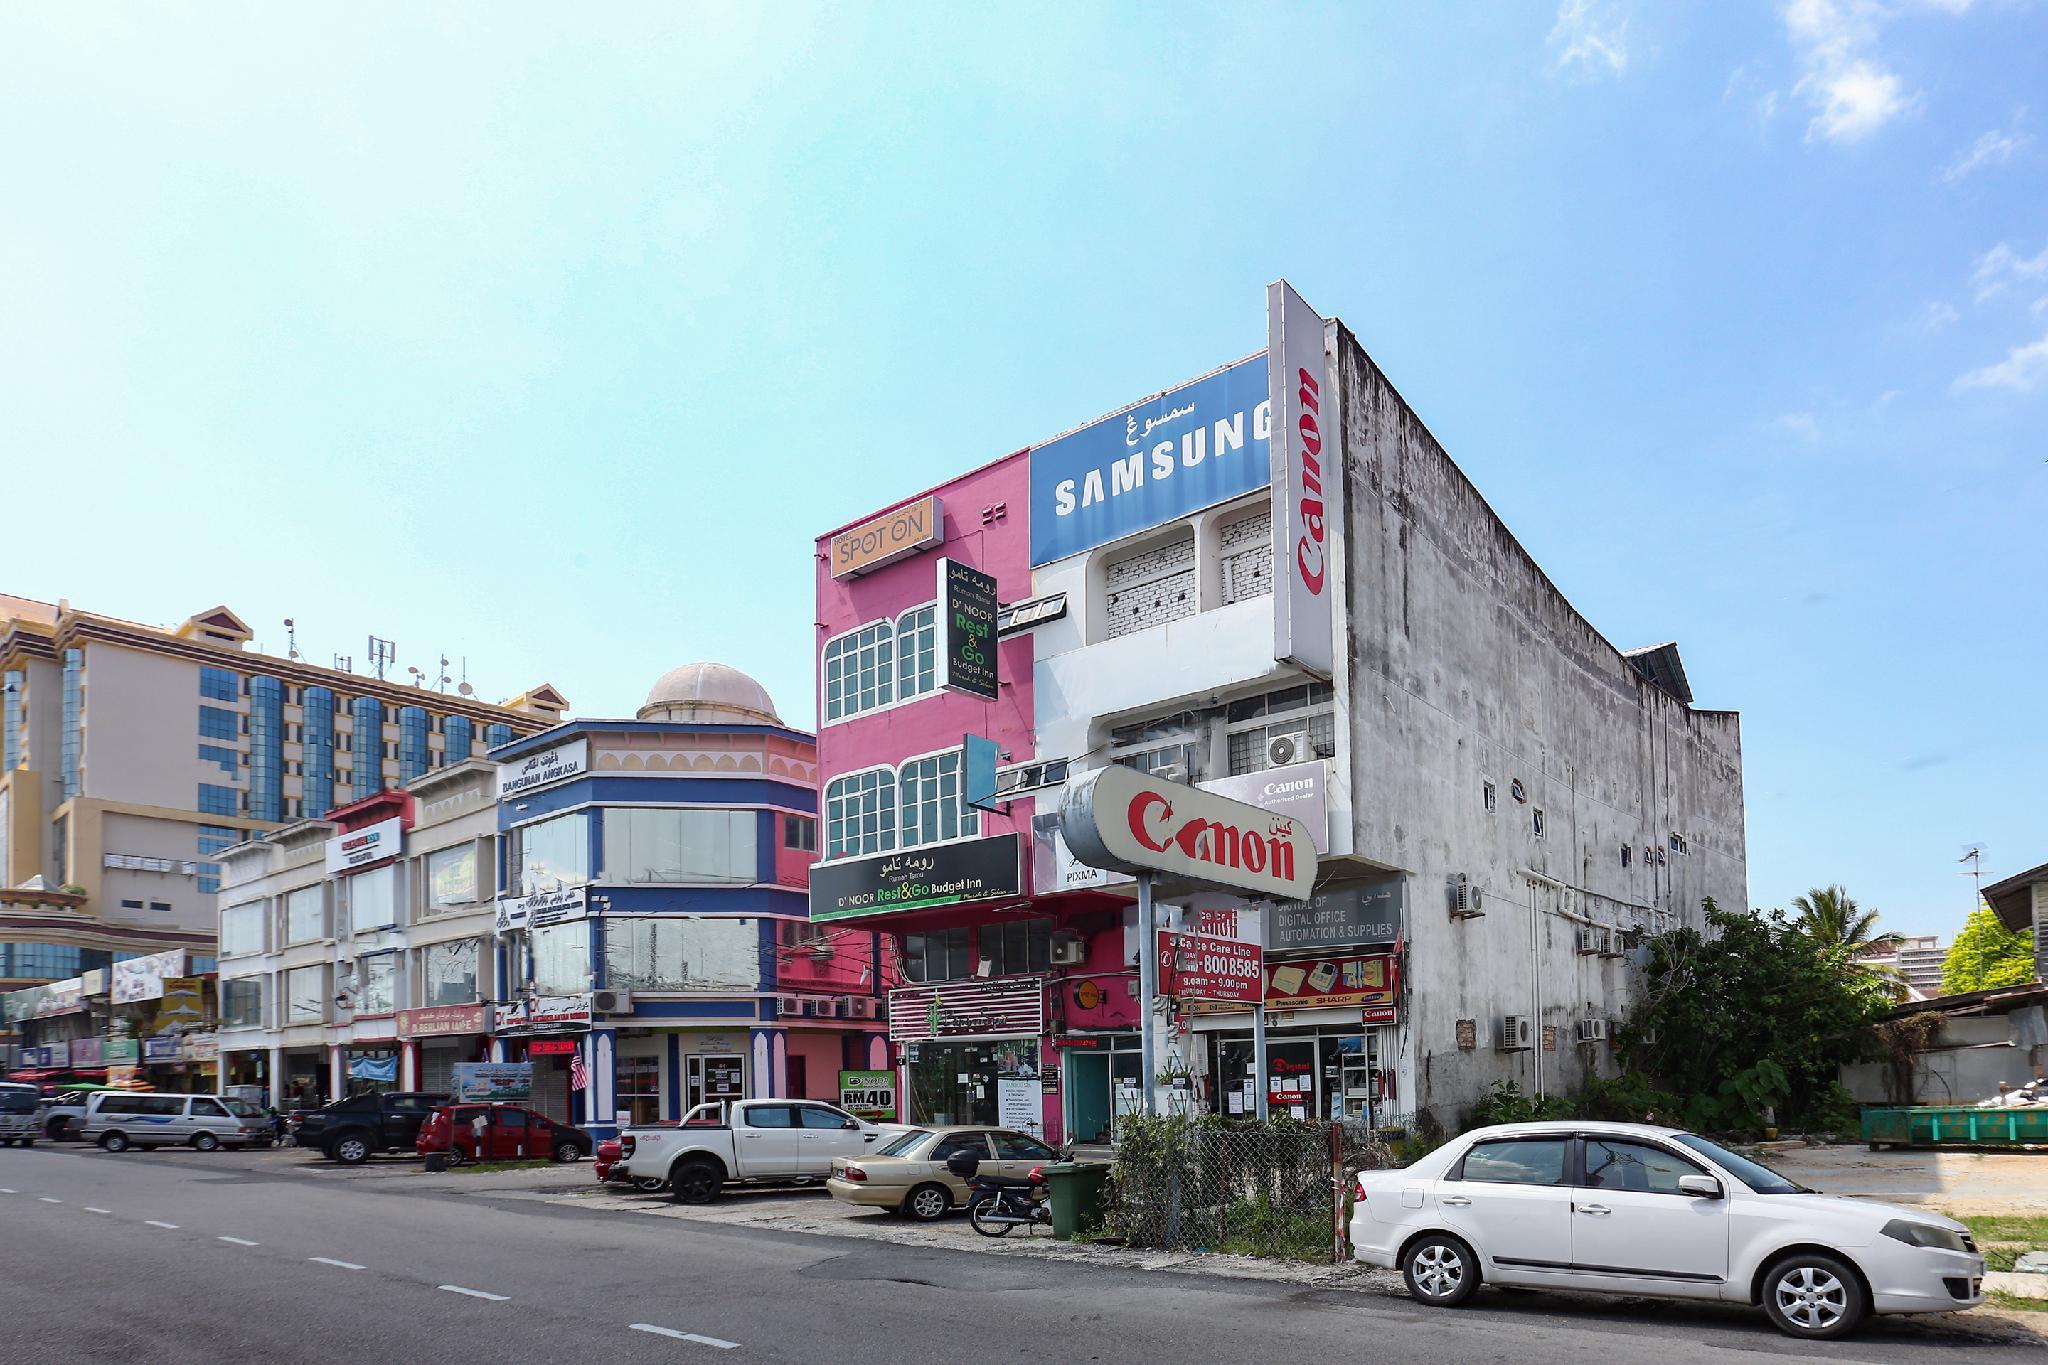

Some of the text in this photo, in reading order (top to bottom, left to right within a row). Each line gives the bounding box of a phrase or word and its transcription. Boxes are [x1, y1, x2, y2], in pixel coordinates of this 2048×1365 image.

[1055, 400, 1271, 517] SAMSUNG
[1297, 368, 1324, 596] Canon
[840, 526, 886, 564] SPOT
[891, 510, 923, 541] ON
[964, 603, 993, 623] NOOR
[956, 613, 989, 638] Rest
[968, 634, 978, 649] &
[962, 645, 985, 665] Go
[953, 657, 981, 675] Budget
[543, 761, 579, 781] ANGKASA
[1264, 777, 1313, 795] Canon
[1127, 791, 1295, 881] Canon
[1066, 868, 1098, 883] PIXMA
[849, 894, 874, 906] NOOR
[931, 878, 965, 896] Budget
[967, 878, 982, 889] Inn
[1278, 910, 1346, 927] DIGITAL OFFICE
[1280, 926, 1336, 942] AUTOMATION
[1348, 923, 1393, 937] SUPPLIES
[1210, 942, 1230, 953] Care
[1233, 945, 1251, 957] Line
[1316, 996, 1352, 1004] SHARP
[1365, 1010, 1393, 1018] Canon
